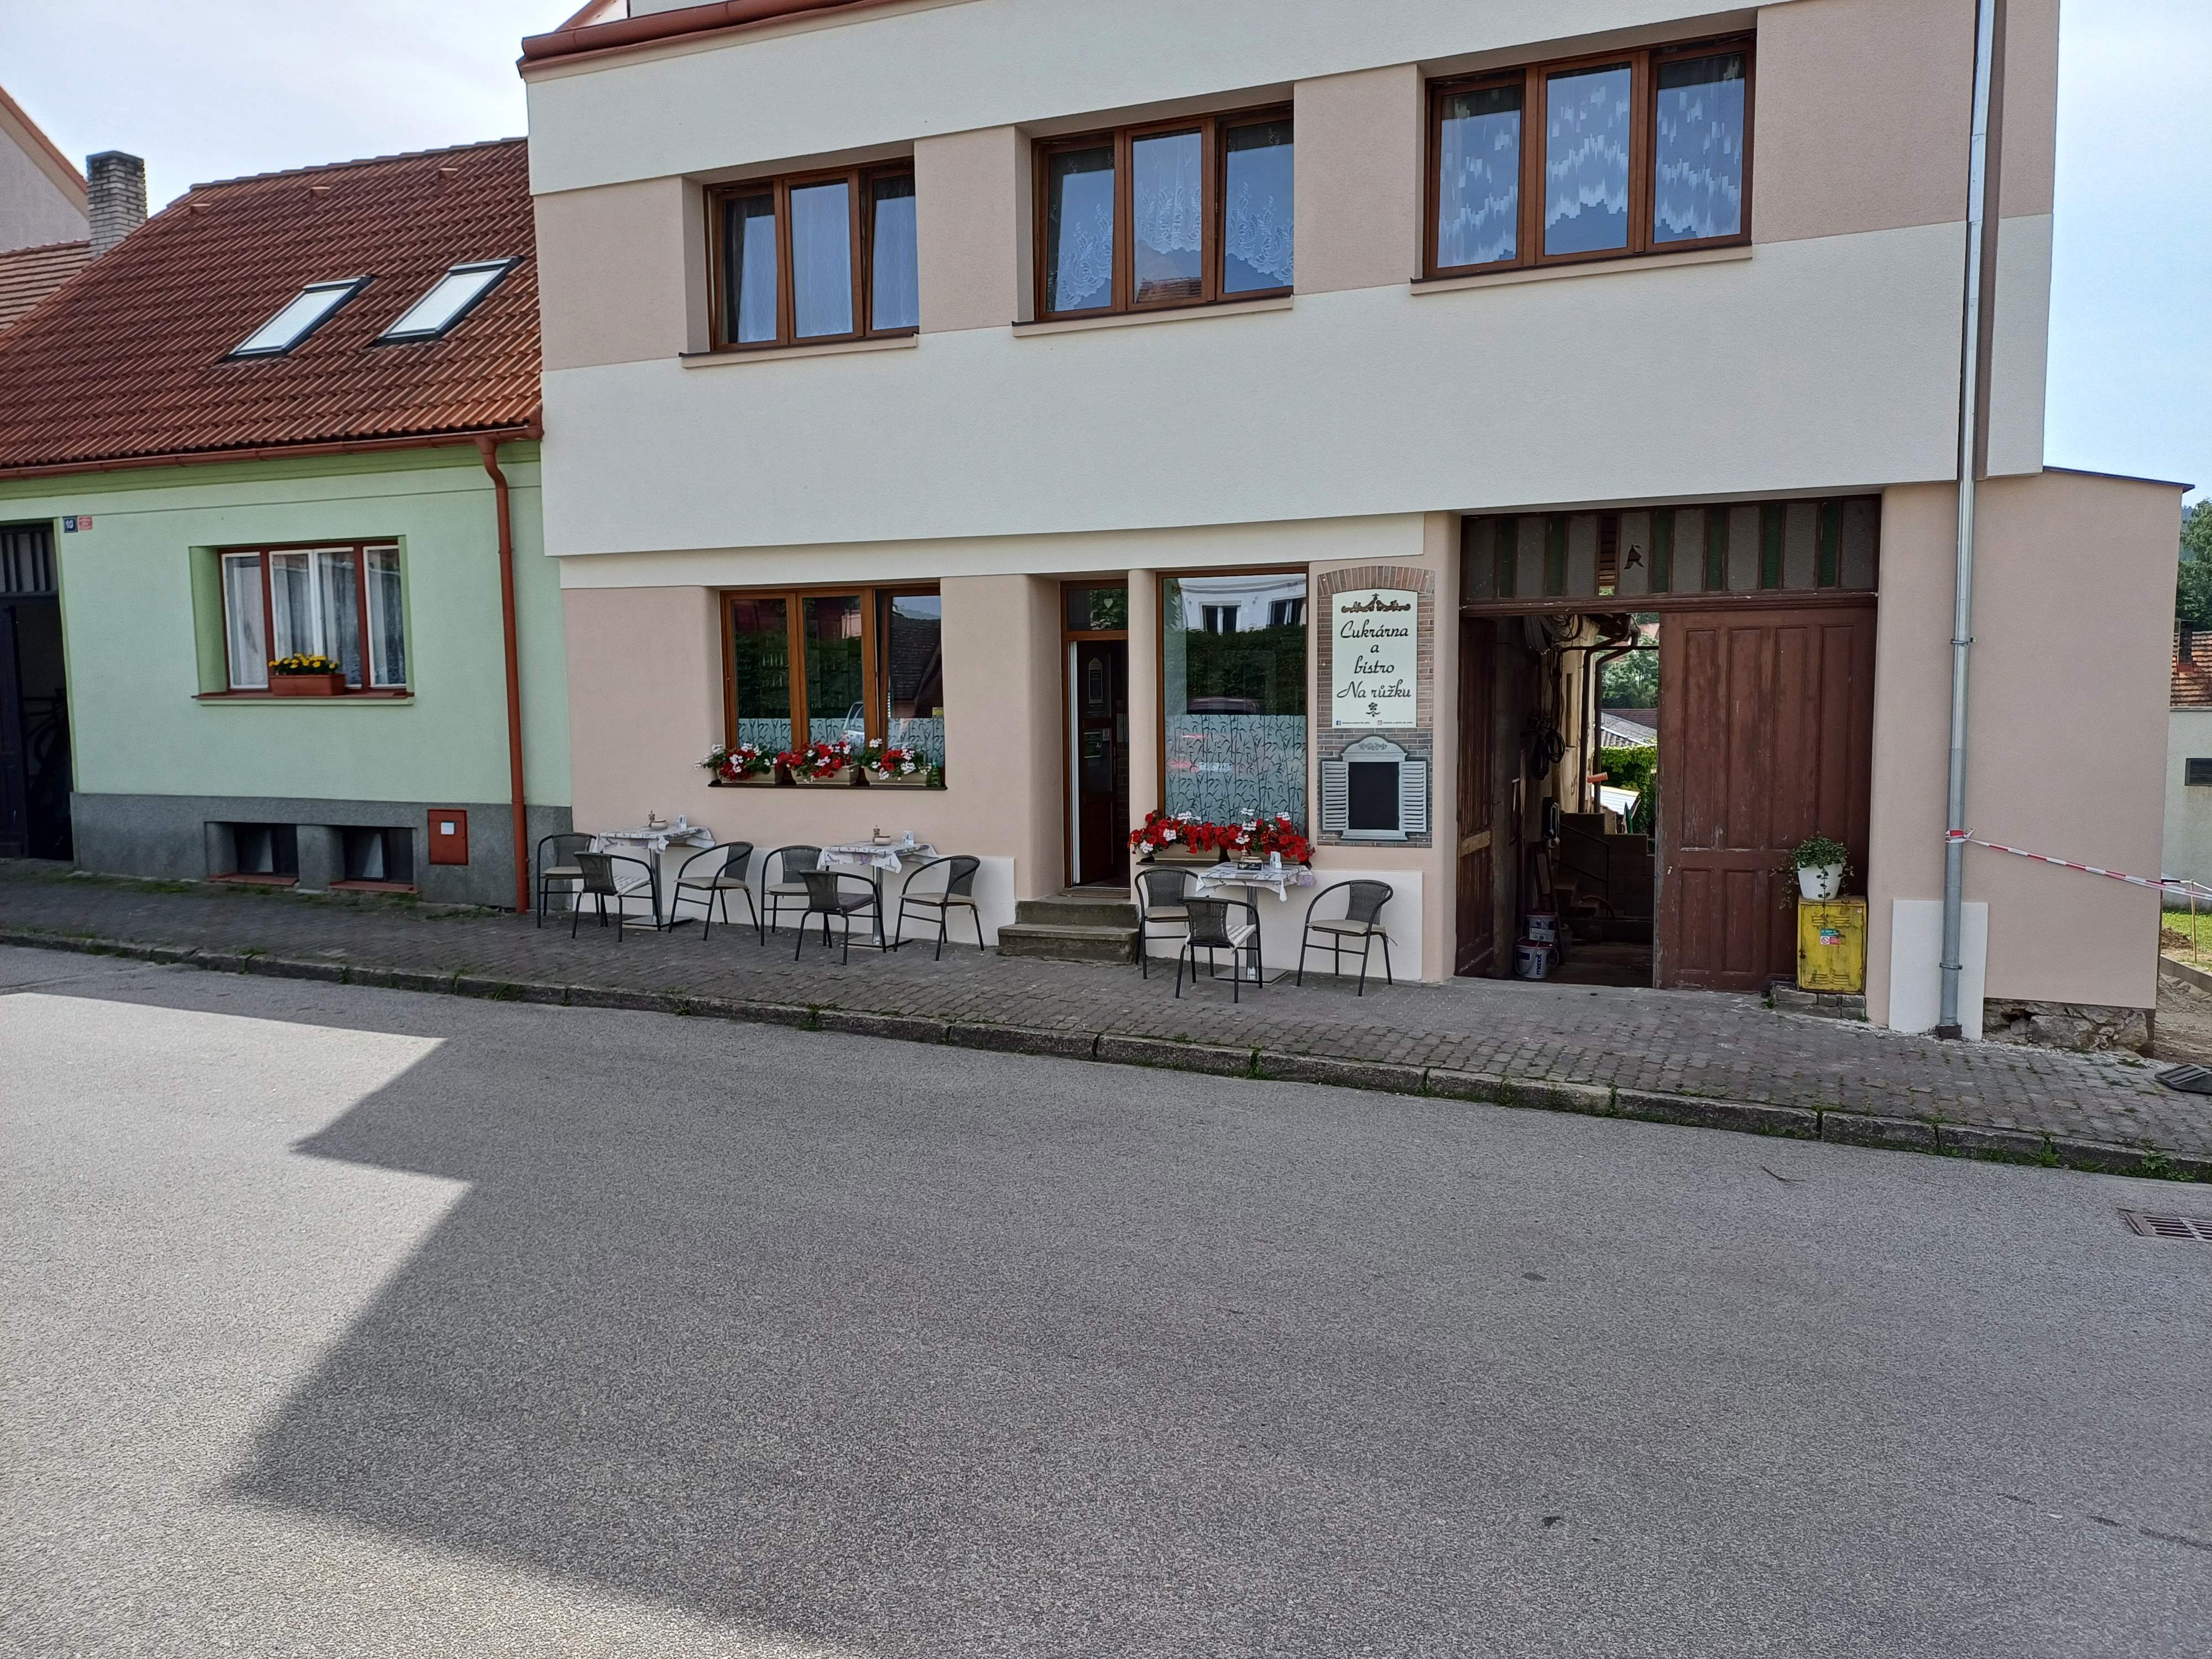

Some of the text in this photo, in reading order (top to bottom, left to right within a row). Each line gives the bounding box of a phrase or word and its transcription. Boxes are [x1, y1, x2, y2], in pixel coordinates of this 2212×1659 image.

[1340, 619, 1409, 638] Cukrárna
[1370, 644, 1380, 653] a
[1354, 655, 1395, 674] bistro
[1337, 679, 1411, 698] Na růžku
